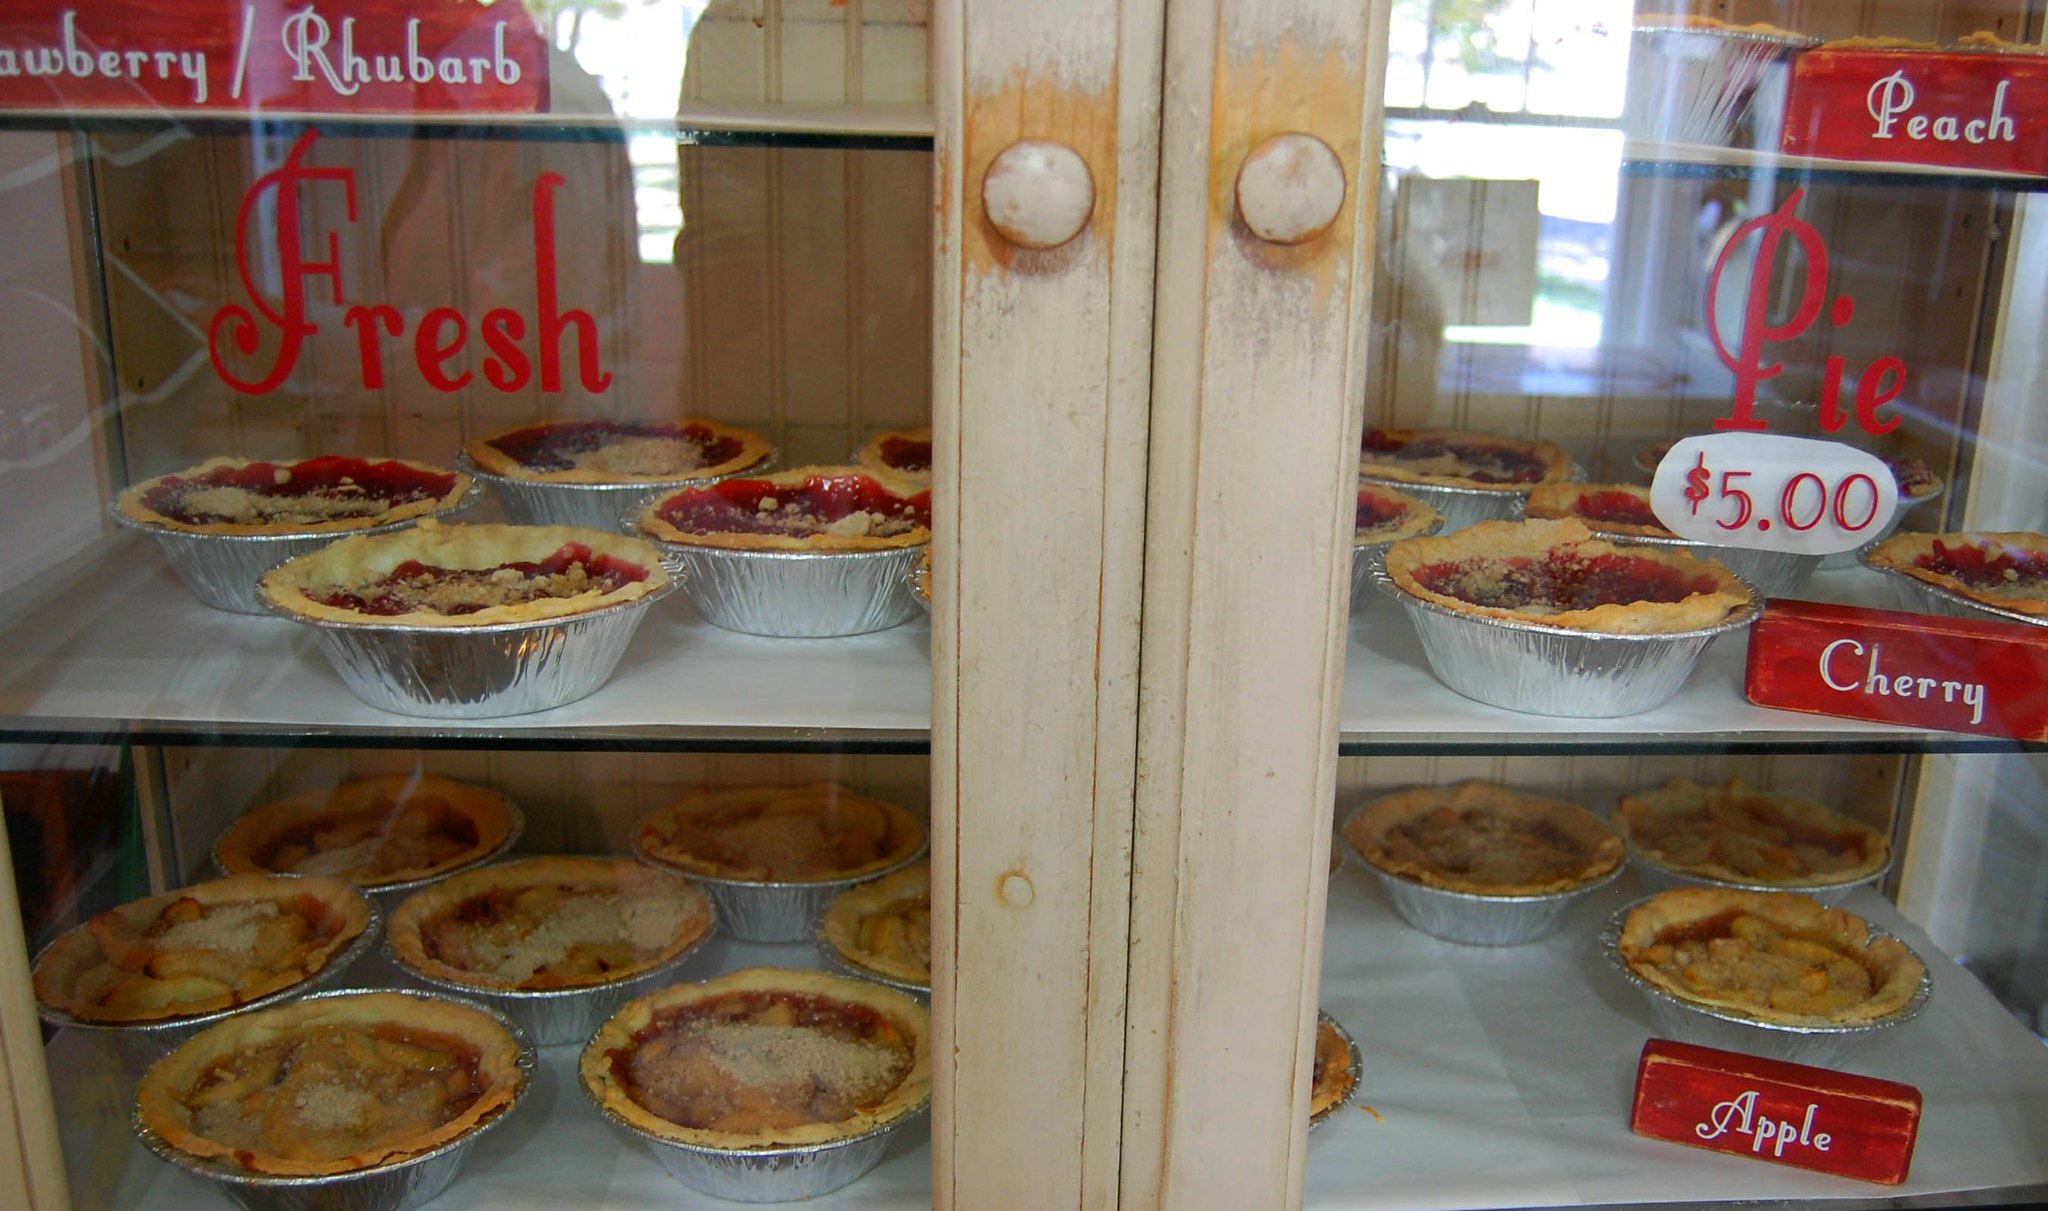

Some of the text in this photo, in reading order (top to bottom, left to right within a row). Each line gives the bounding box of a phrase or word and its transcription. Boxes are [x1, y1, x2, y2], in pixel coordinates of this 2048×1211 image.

[0, 6, 521, 103] awberry / Rhubarb
[1866, 70, 2015, 144] Peach
[208, 128, 612, 395] Fresh
[1706, 187, 1908, 436] Pie
[1683, 451, 1879, 533] $5.00
[1819, 638, 1984, 724] Cherry
[1695, 1090, 1832, 1157] Apple
